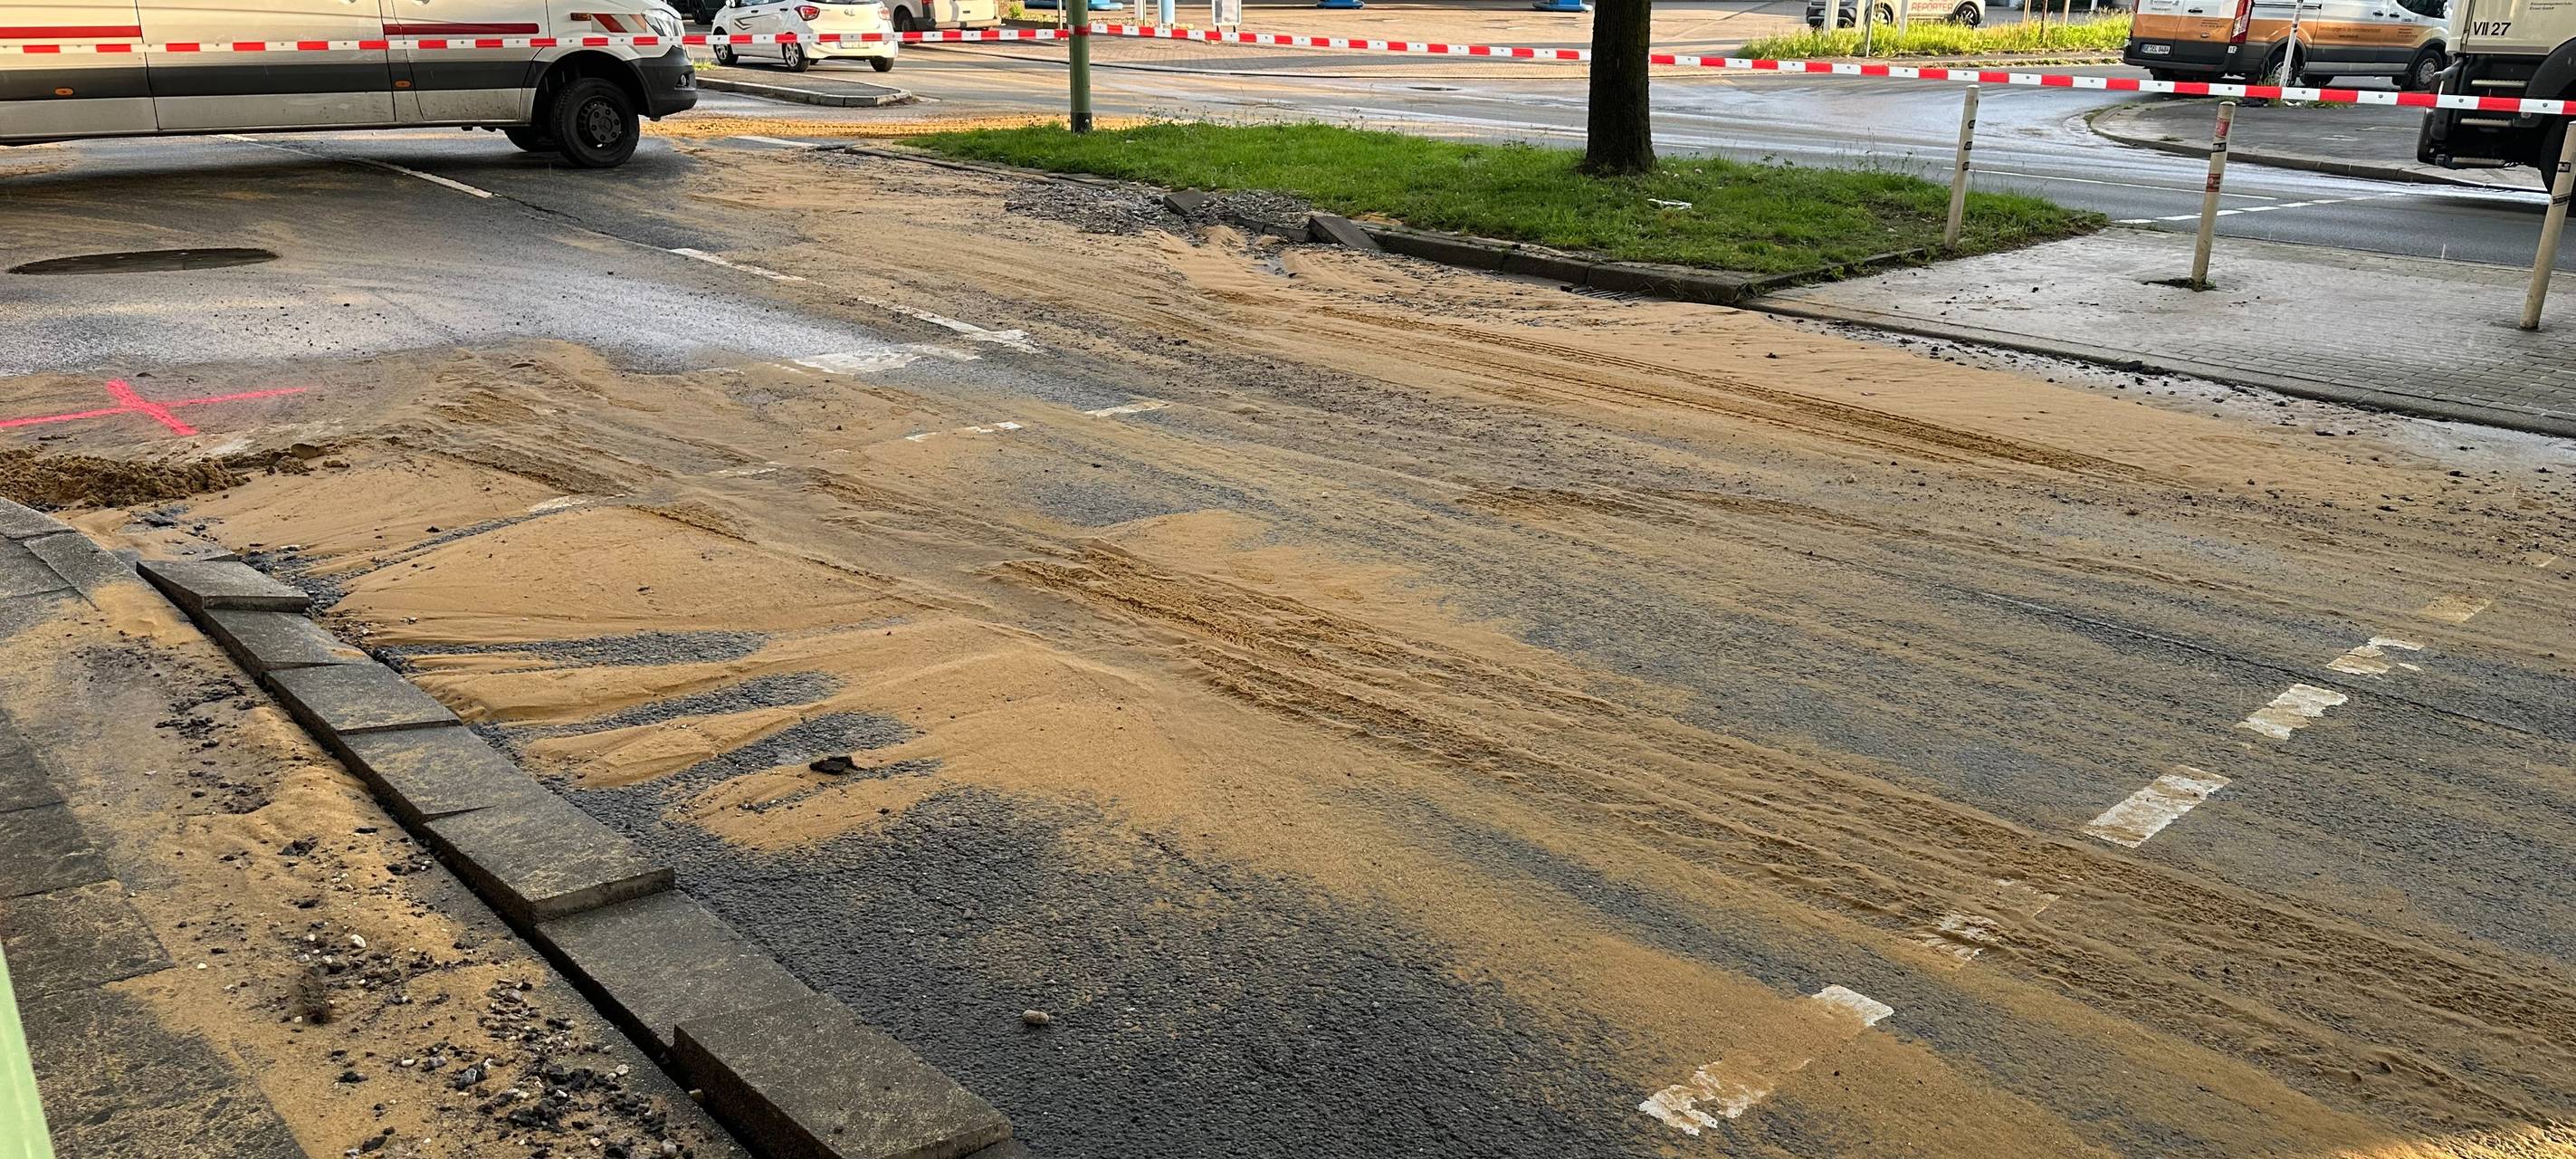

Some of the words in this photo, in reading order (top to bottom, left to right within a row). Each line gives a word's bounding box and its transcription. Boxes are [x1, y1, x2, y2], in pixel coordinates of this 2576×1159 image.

[1912, 3, 1953, 12] REPORTER
[2473, 22, 2489, 35] VII
[2491, 22, 2511, 35] 27
